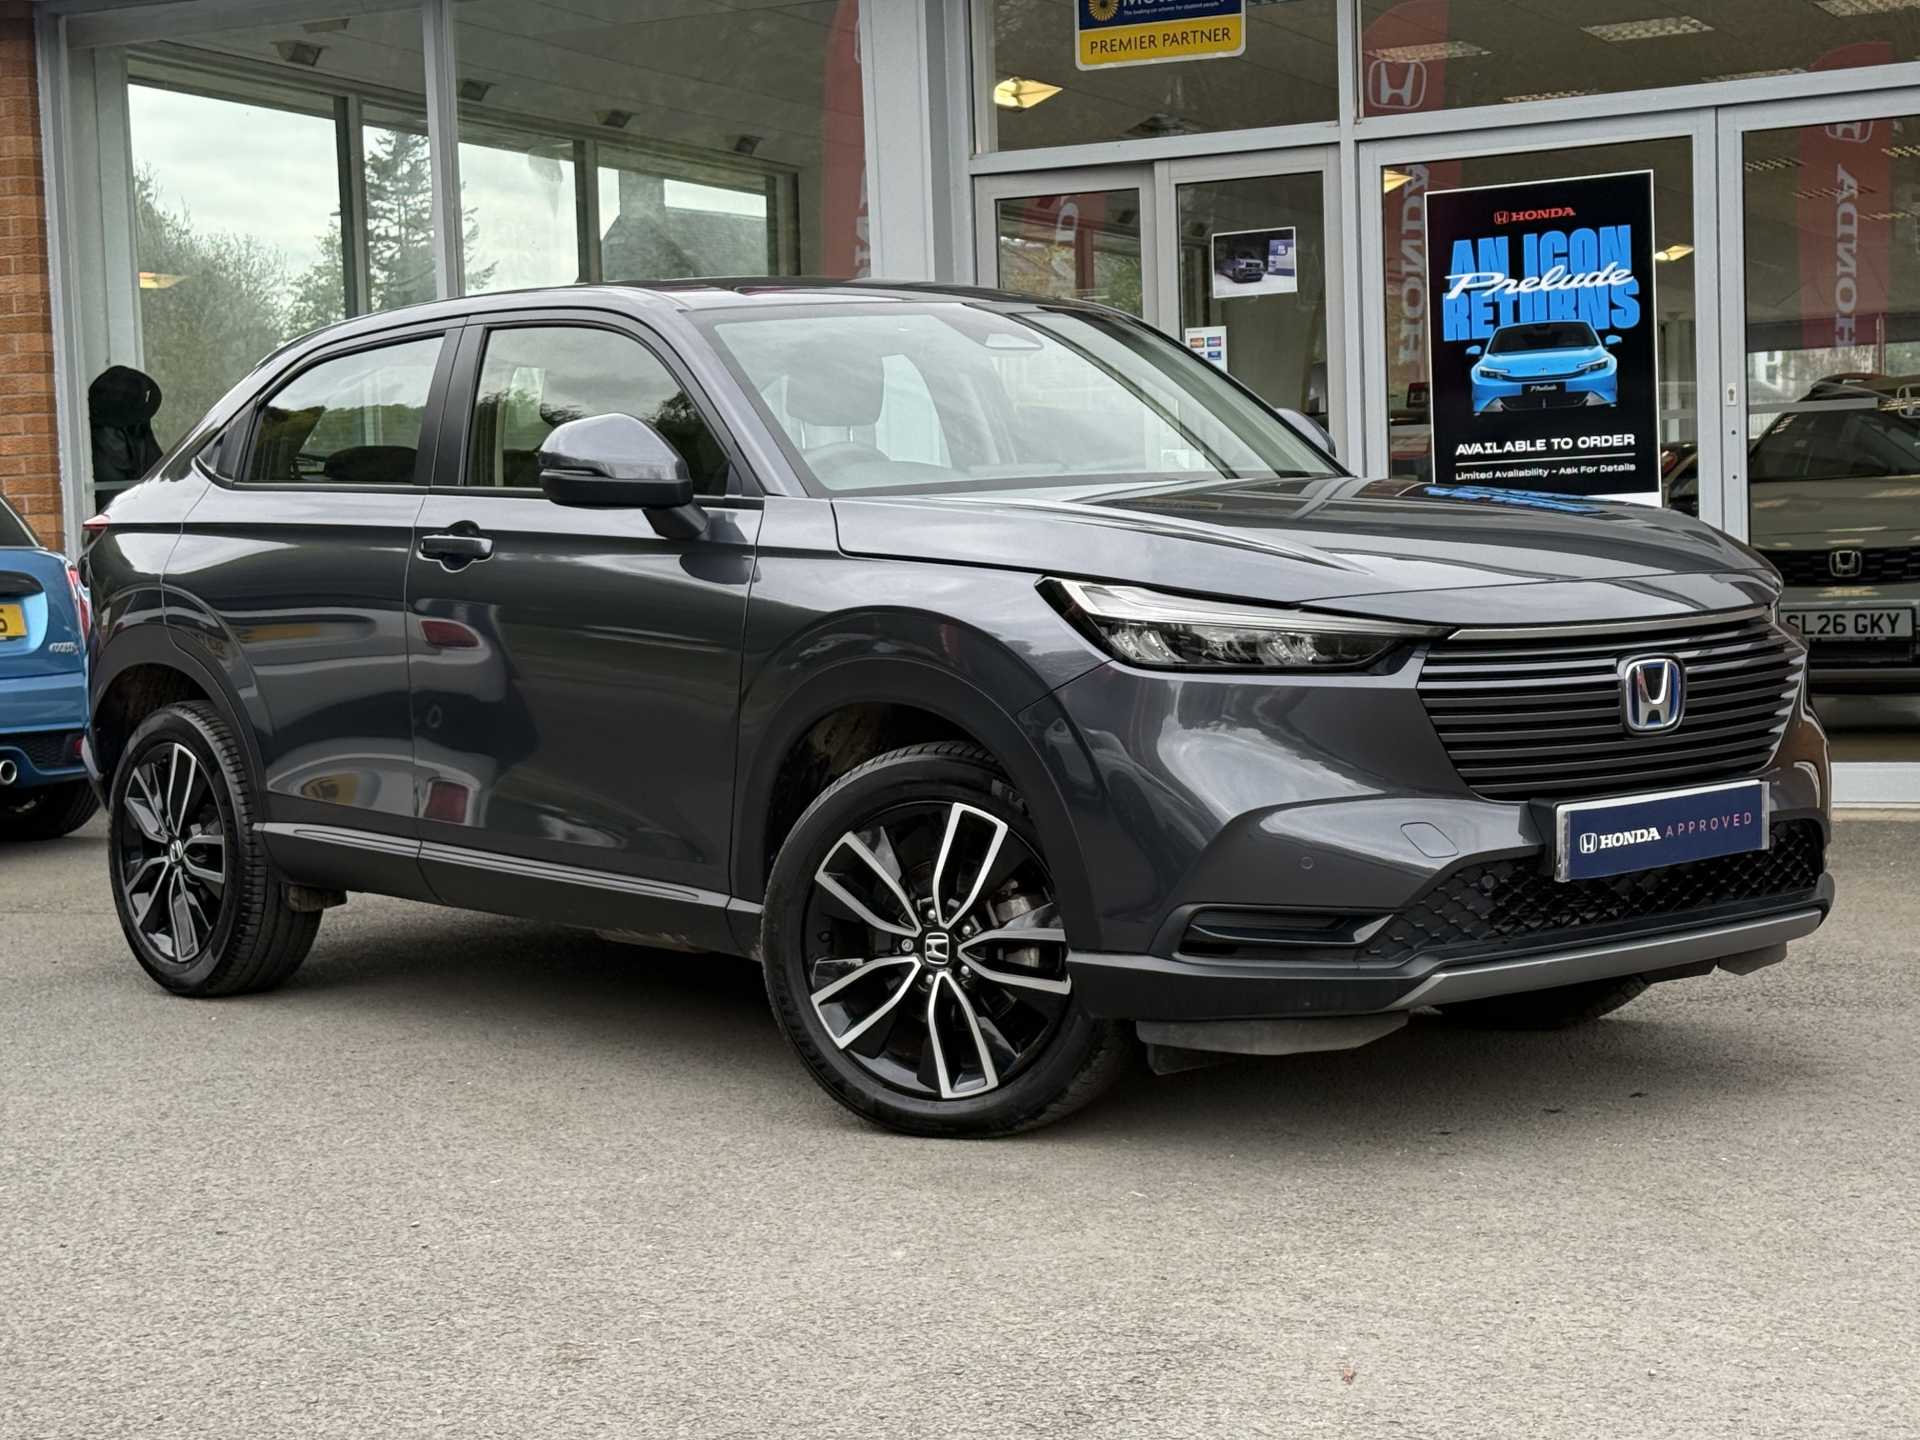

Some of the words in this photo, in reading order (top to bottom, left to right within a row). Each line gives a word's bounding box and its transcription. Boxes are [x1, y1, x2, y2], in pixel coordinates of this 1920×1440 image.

[1090, 34, 1158, 55] PREMIER
[1162, 27, 1231, 47] PARTNER
[1511, 207, 1576, 222] HONDA
[1449, 236, 1509, 290] AN
[1523, 224, 1632, 284] ICON
[1444, 261, 1634, 300] Prelude
[1442, 278, 1640, 342] RETURNS
[1455, 439, 1547, 457] AVAILABLE
[1551, 437, 1573, 450] TO
[1577, 433, 1636, 449] ORDER
[1455, 470, 1493, 481] Limited
[1494, 467, 1550, 479] Availability
[1558, 466, 1578, 475] Ask
[1580, 464, 1598, 474] For
[1600, 463, 1636, 473] Details
[1785, 613, 1847, 635] SL26
[1854, 612, 1900, 635] GKY
[1599, 826, 1662, 850] HONDA
[1665, 811, 1752, 838] APPROVED
